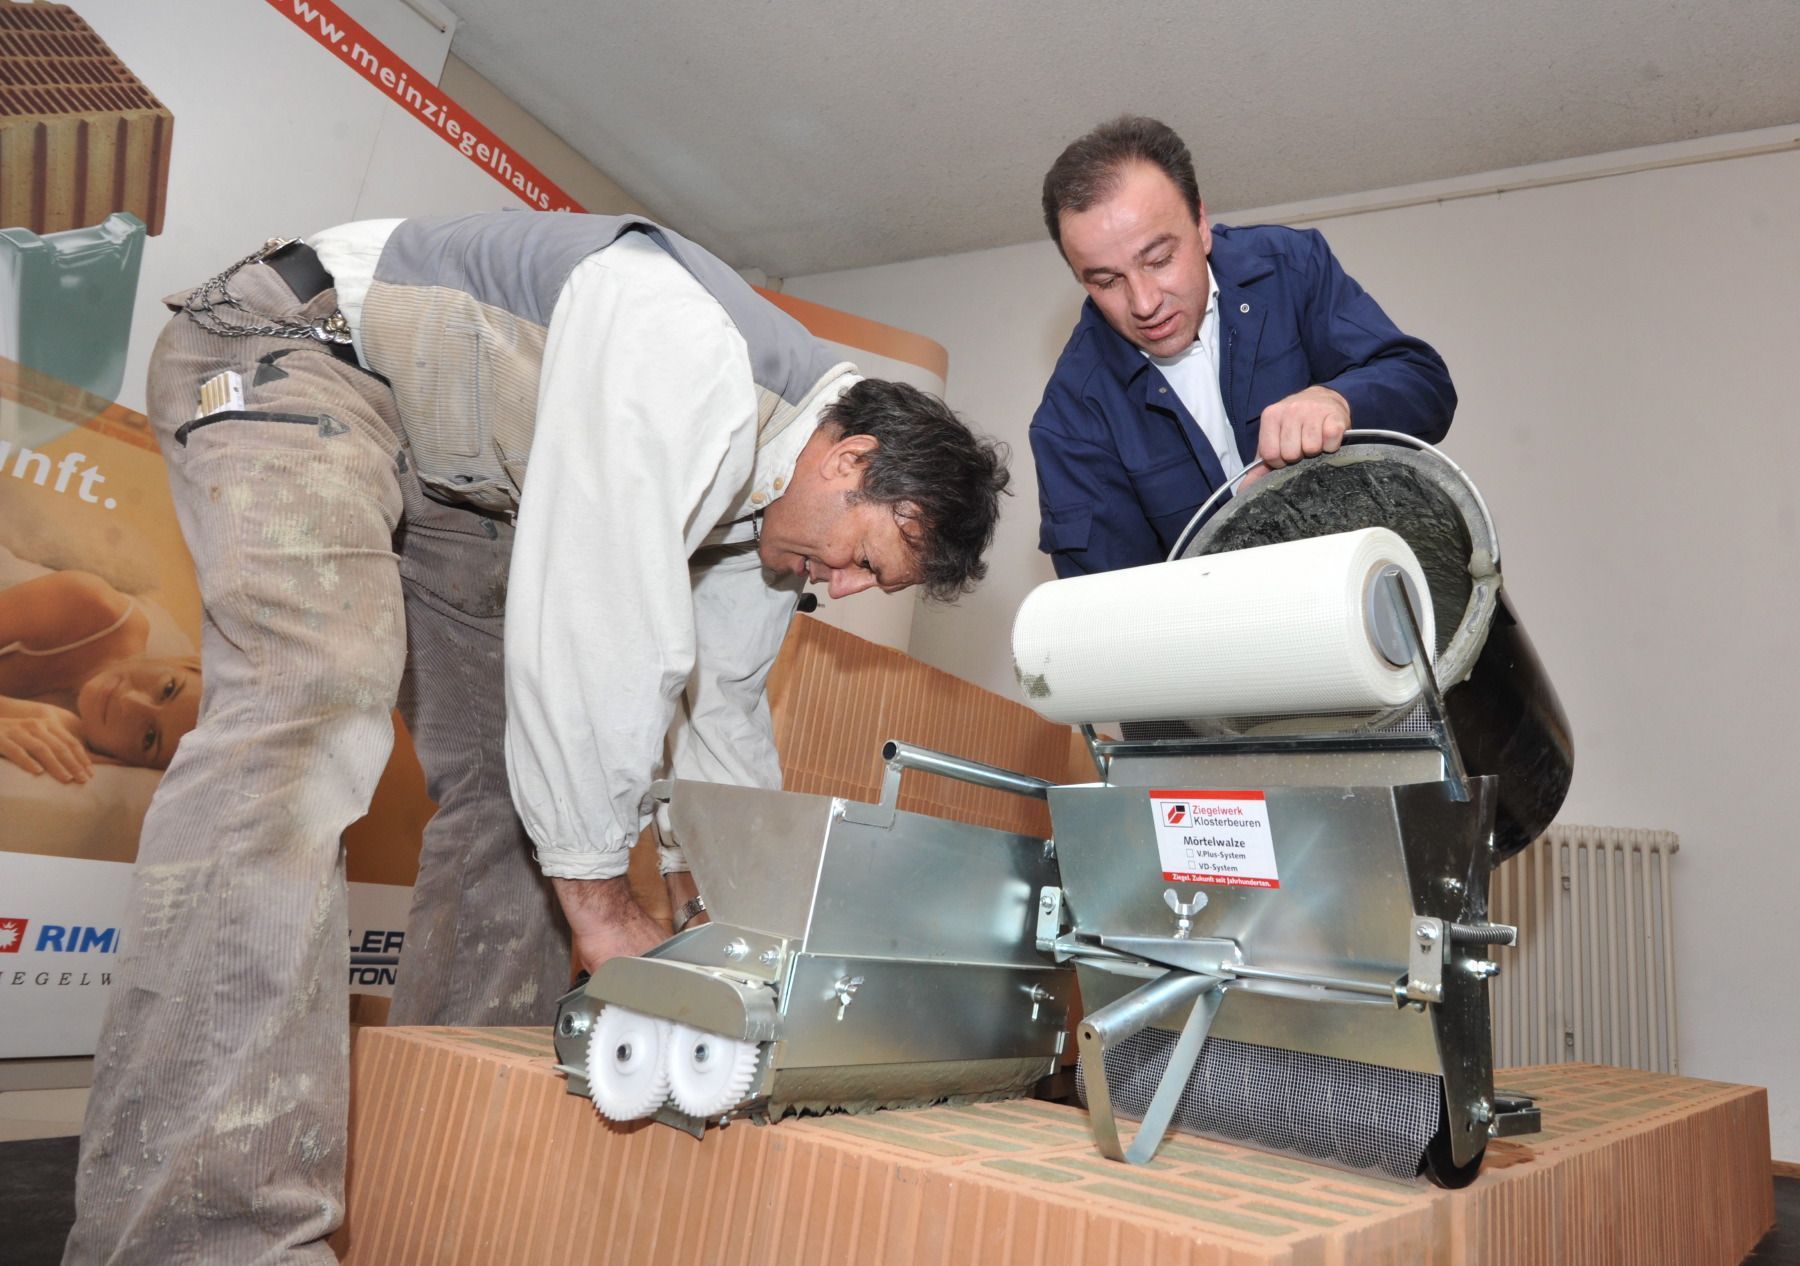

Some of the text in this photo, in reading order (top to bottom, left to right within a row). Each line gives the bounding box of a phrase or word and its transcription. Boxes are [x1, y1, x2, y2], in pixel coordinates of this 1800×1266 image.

[1192, 804, 1243, 816] Ziegelwerk
[1194, 817, 1261, 828] Klosterbeuren
[1183, 835, 1246, 848] Mörtelwalze
[1196, 850, 1246, 860] V.Plus-System
[1198, 863, 1238, 872] VD-System
[1172, 873, 1191, 882] Ziegel.
[1192, 875, 1215, 883] Zukunft
[1227, 877, 1271, 887] Jahrhunderten.
[35, 925, 121, 953] RIM
